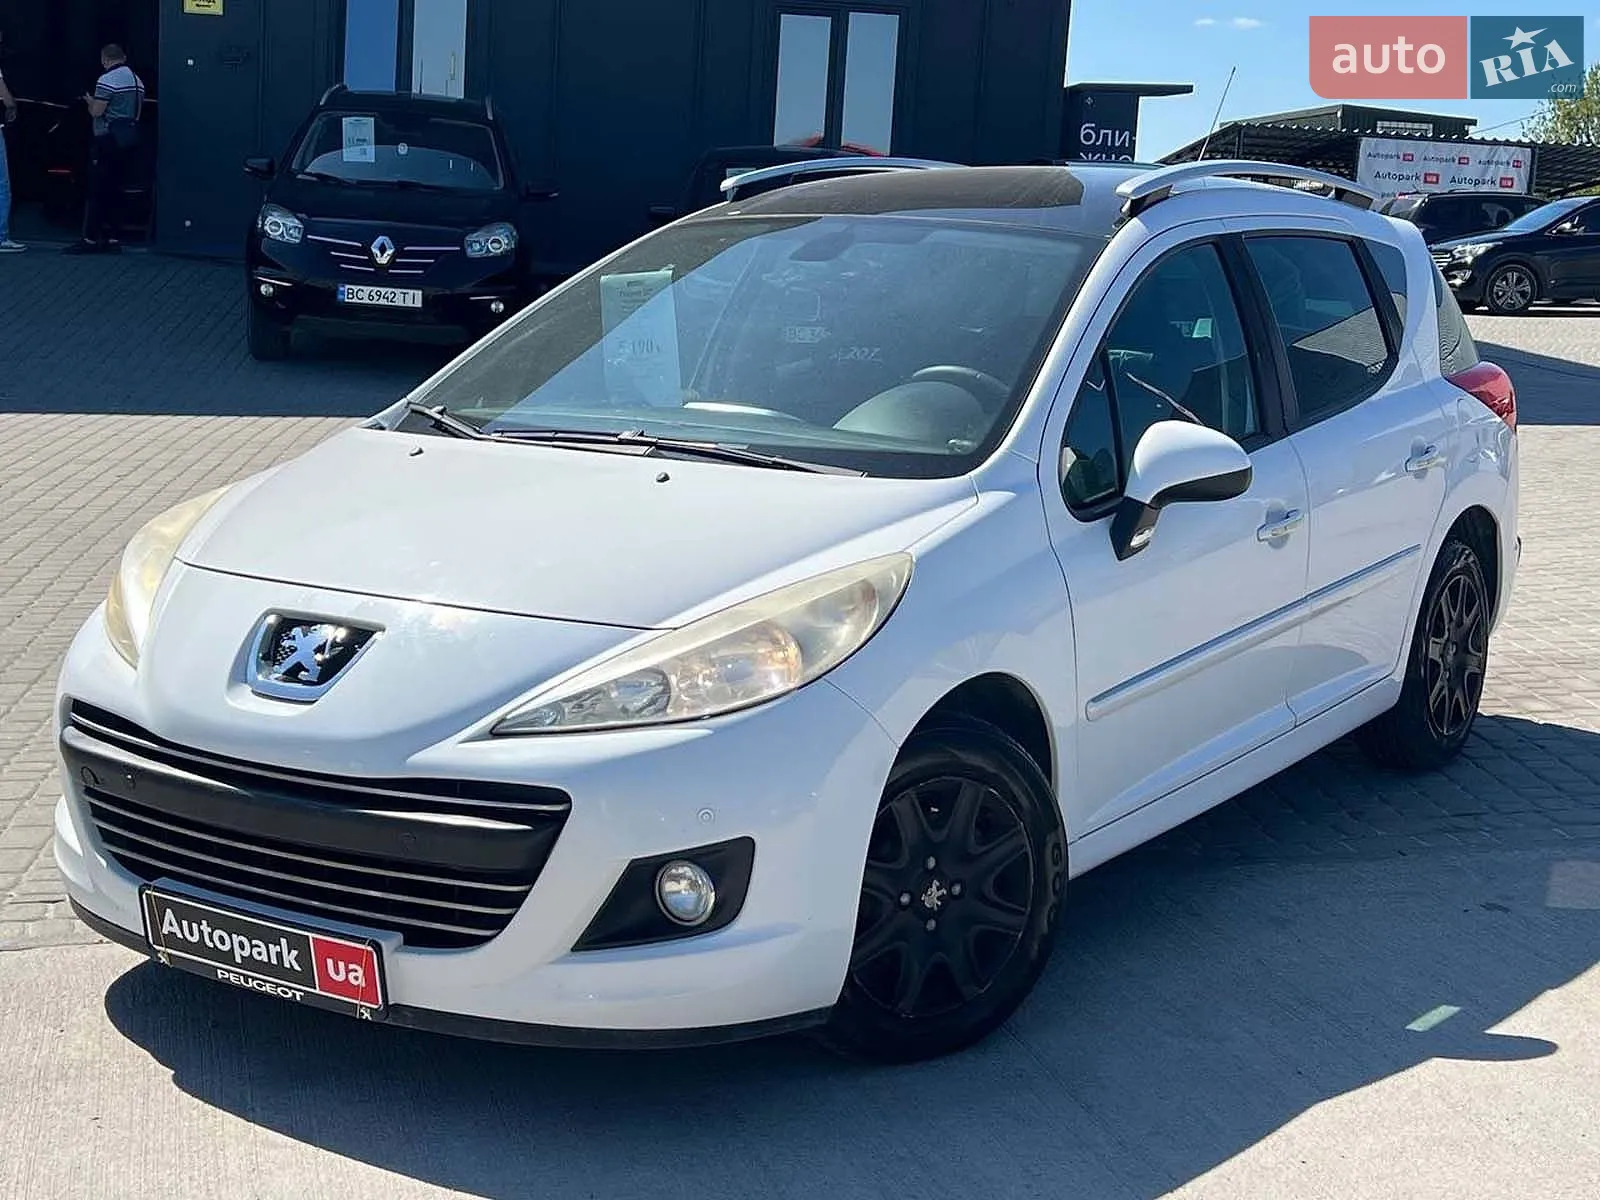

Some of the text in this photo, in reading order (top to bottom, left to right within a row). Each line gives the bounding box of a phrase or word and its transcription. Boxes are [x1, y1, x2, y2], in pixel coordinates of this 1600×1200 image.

[1374, 171, 1422, 182] Autopark
[1450, 175, 1497, 186] Autopark
[346, 287, 365, 301] BC
[368, 289, 397, 304] 6942
[162, 908, 366, 988] Autopark ua
[217, 969, 304, 1001] PEUGEOT
